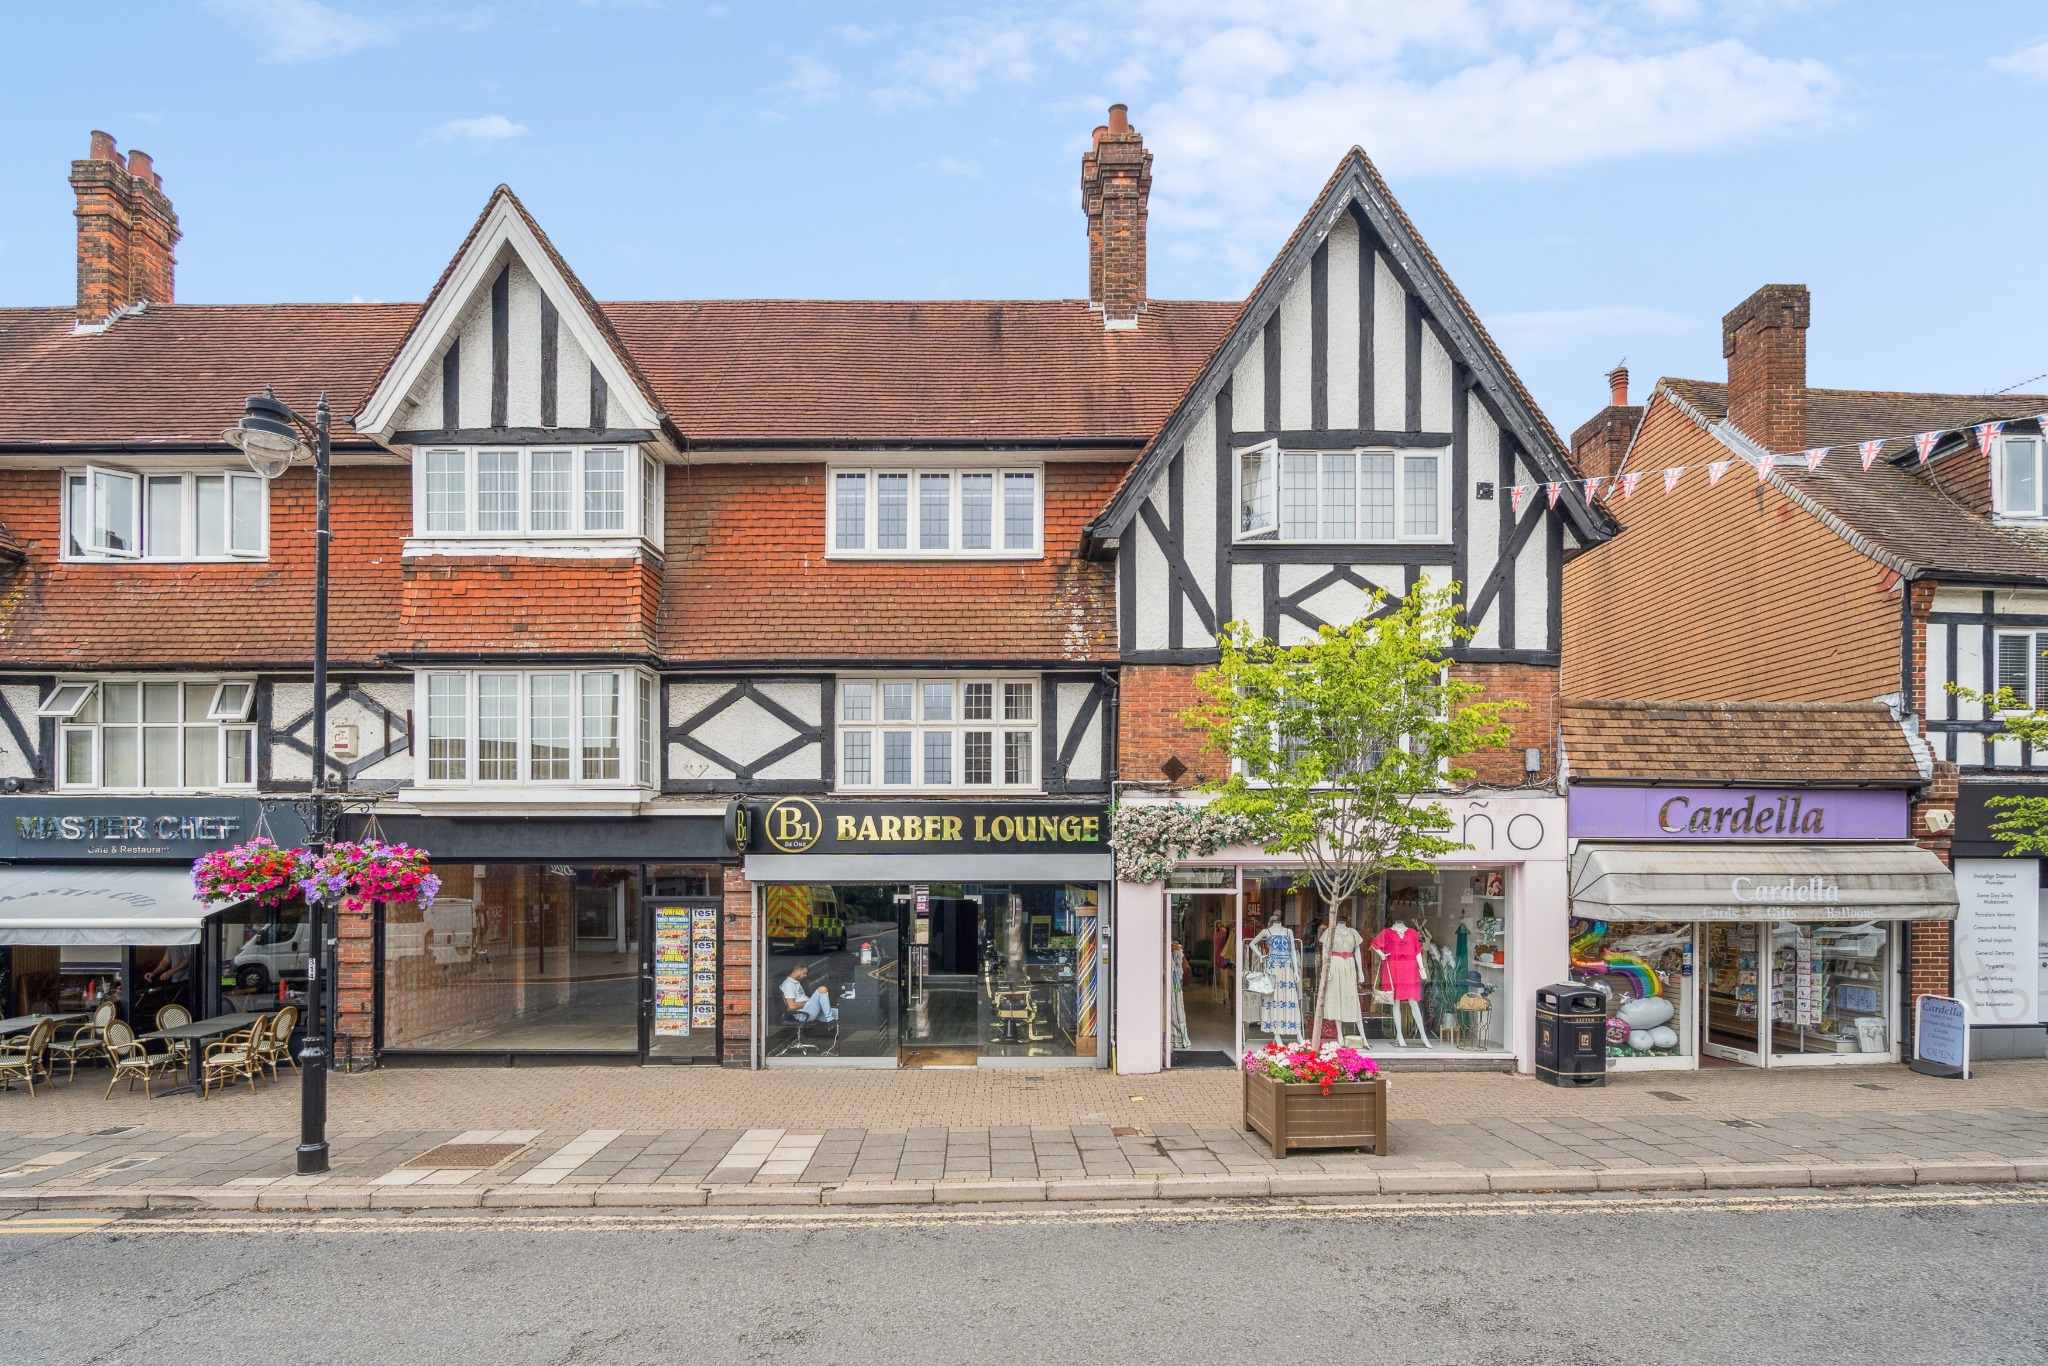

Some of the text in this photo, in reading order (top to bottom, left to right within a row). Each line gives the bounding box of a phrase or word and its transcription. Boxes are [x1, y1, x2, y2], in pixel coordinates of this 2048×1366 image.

[1658, 795, 1824, 834] Cardella
[16, 816, 240, 840] MASTER CHEF
[836, 815, 1100, 842] BARBER LOUNGE
[111, 846, 118, 854] &
[120, 845, 170, 854] Restaurant
[1731, 877, 1840, 902] Cardella
[1248, 903, 1261, 917] SALE
[1703, 906, 1876, 919] Cards Gifts Balloons
[1922, 1003, 1962, 1017] Cardella
[1606, 1027, 1623, 1038] 65
[1926, 1047, 1955, 1061] OPEN
